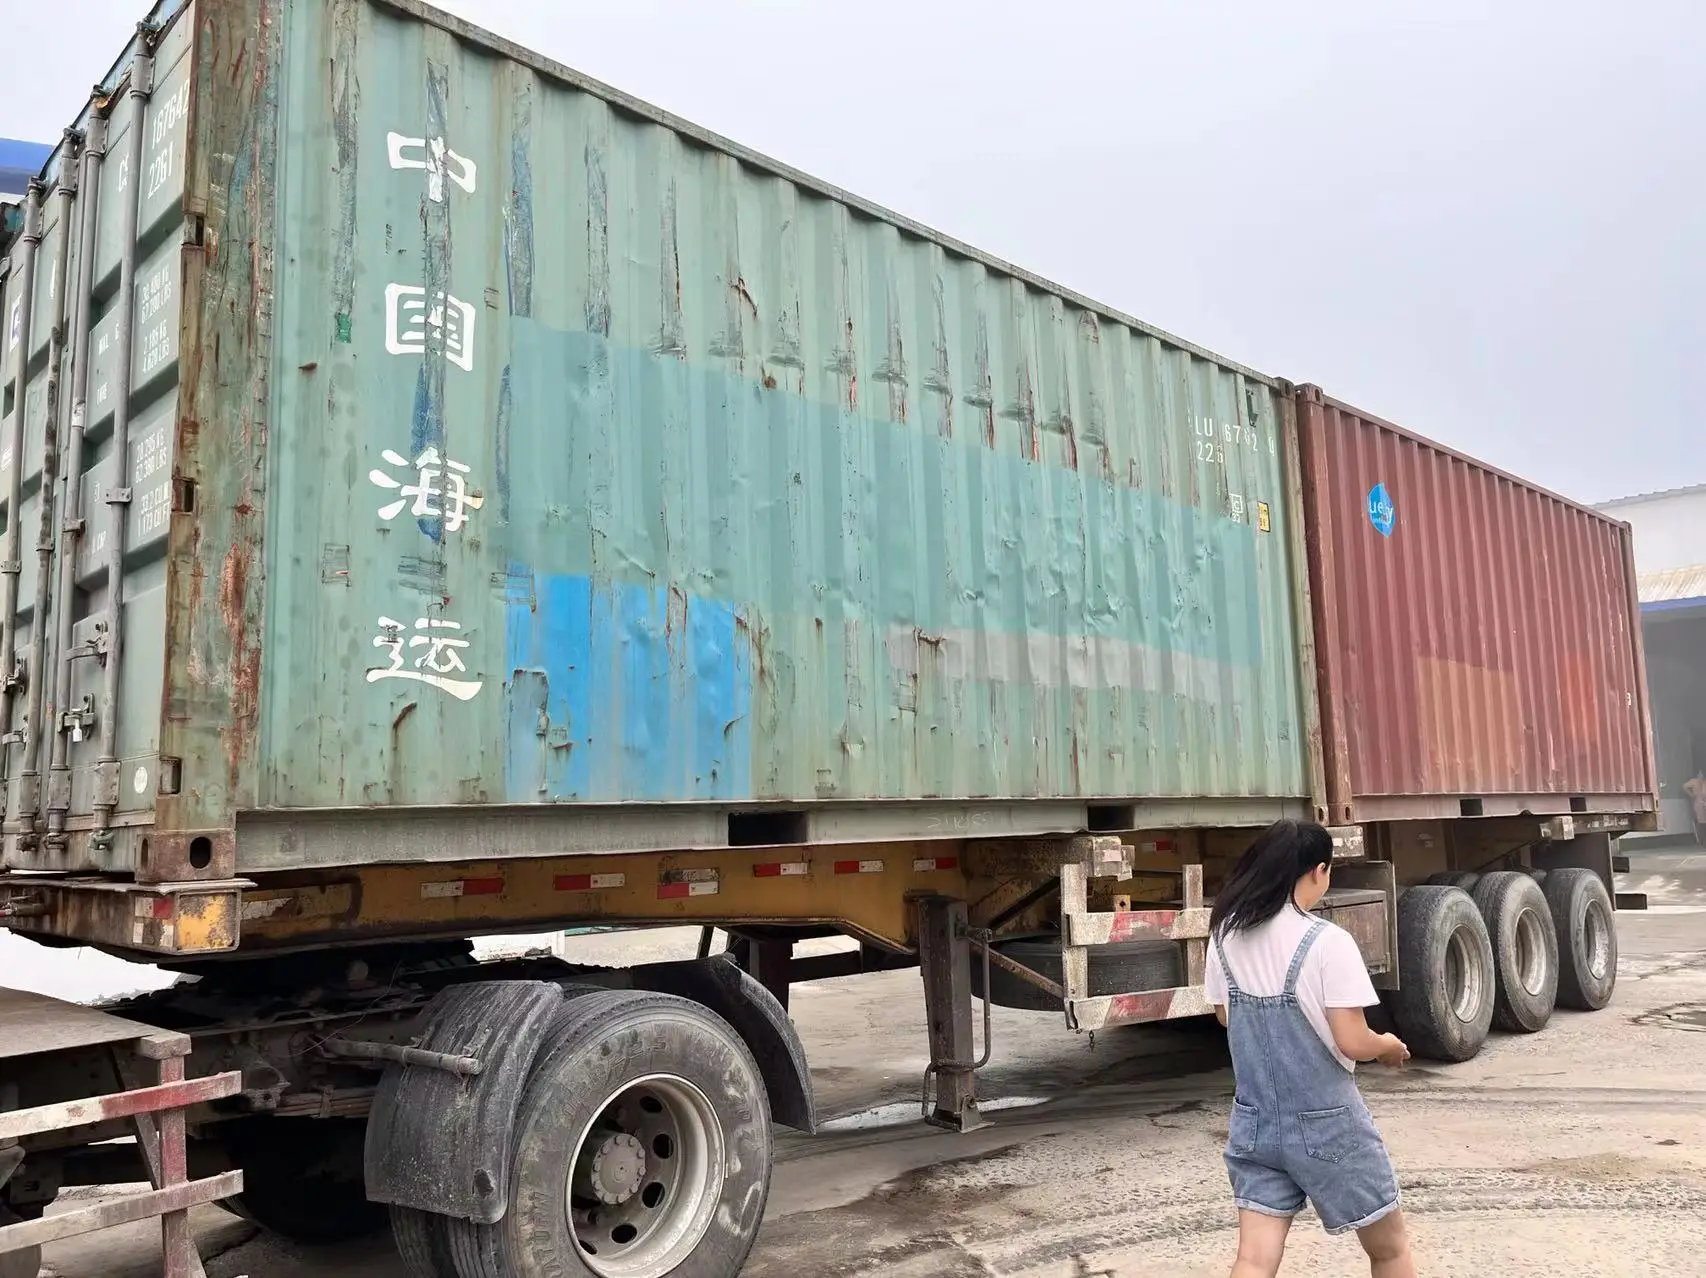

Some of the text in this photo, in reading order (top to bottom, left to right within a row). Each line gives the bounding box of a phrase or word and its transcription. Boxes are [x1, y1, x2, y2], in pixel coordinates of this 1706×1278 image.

[152, 78, 190, 149] 167642
[366, 131, 483, 701] 中国海运
